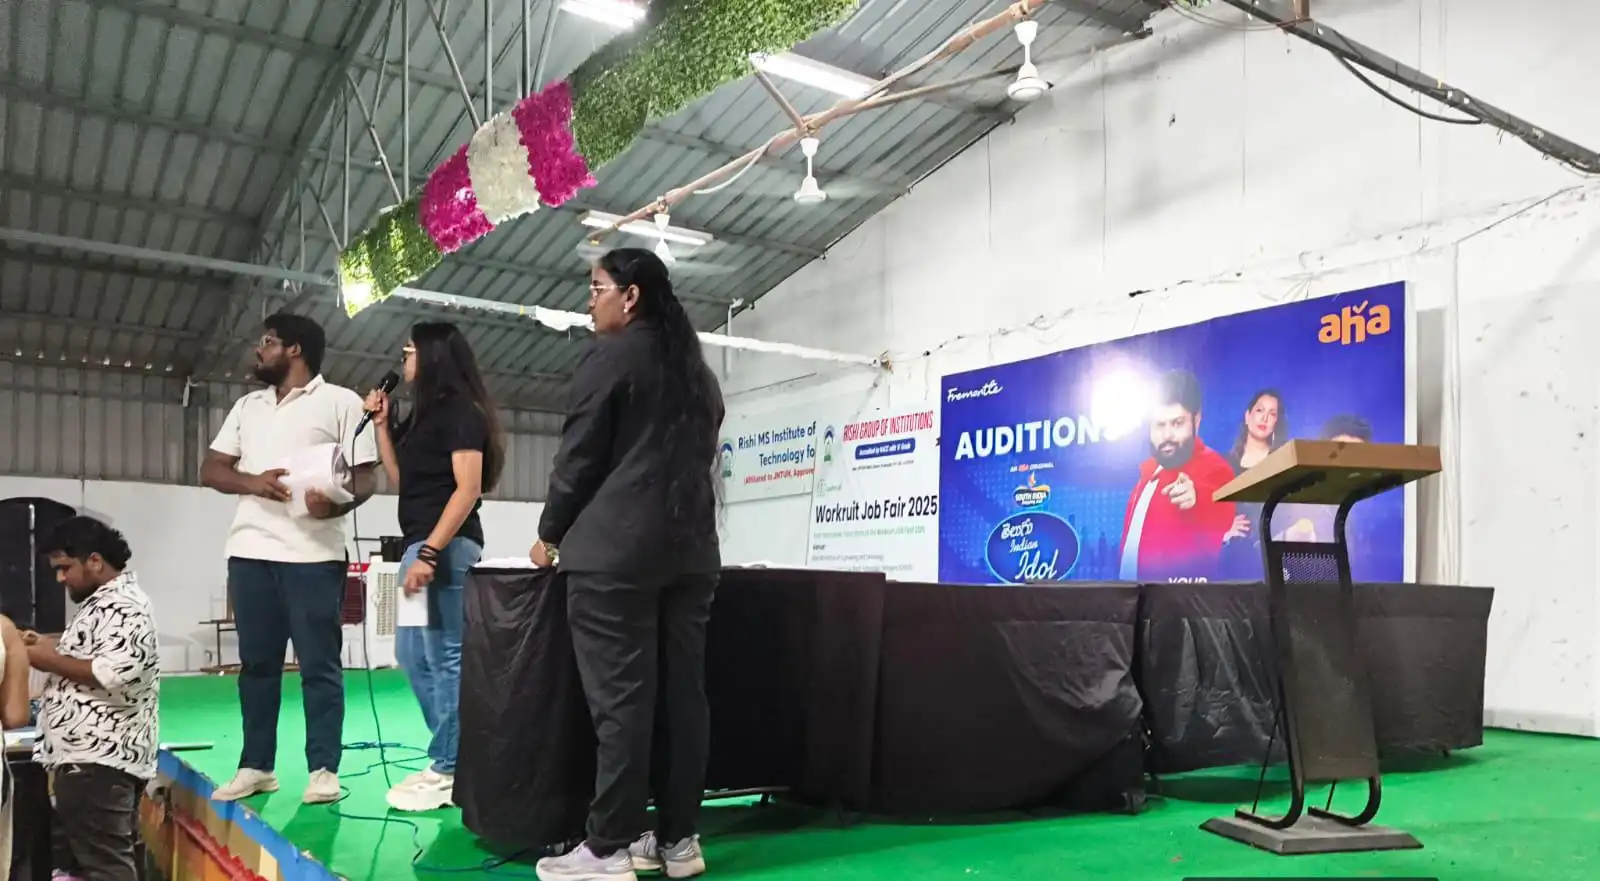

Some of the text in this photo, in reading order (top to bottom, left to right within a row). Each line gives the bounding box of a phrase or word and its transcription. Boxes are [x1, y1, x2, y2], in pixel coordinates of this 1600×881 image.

[1318, 300, 1390, 345] aha
[738, 421, 816, 450] Rishi MS Institute of
[843, 410, 934, 442] RISHI GROUP OF INSTITUTIONS
[759, 447, 805, 467] Technology
[767, 473, 773, 481] to
[815, 495, 938, 523] Workruit Job Fair 2025
[1010, 538, 1039, 553] Indian
[1015, 548, 1059, 580] Idol
